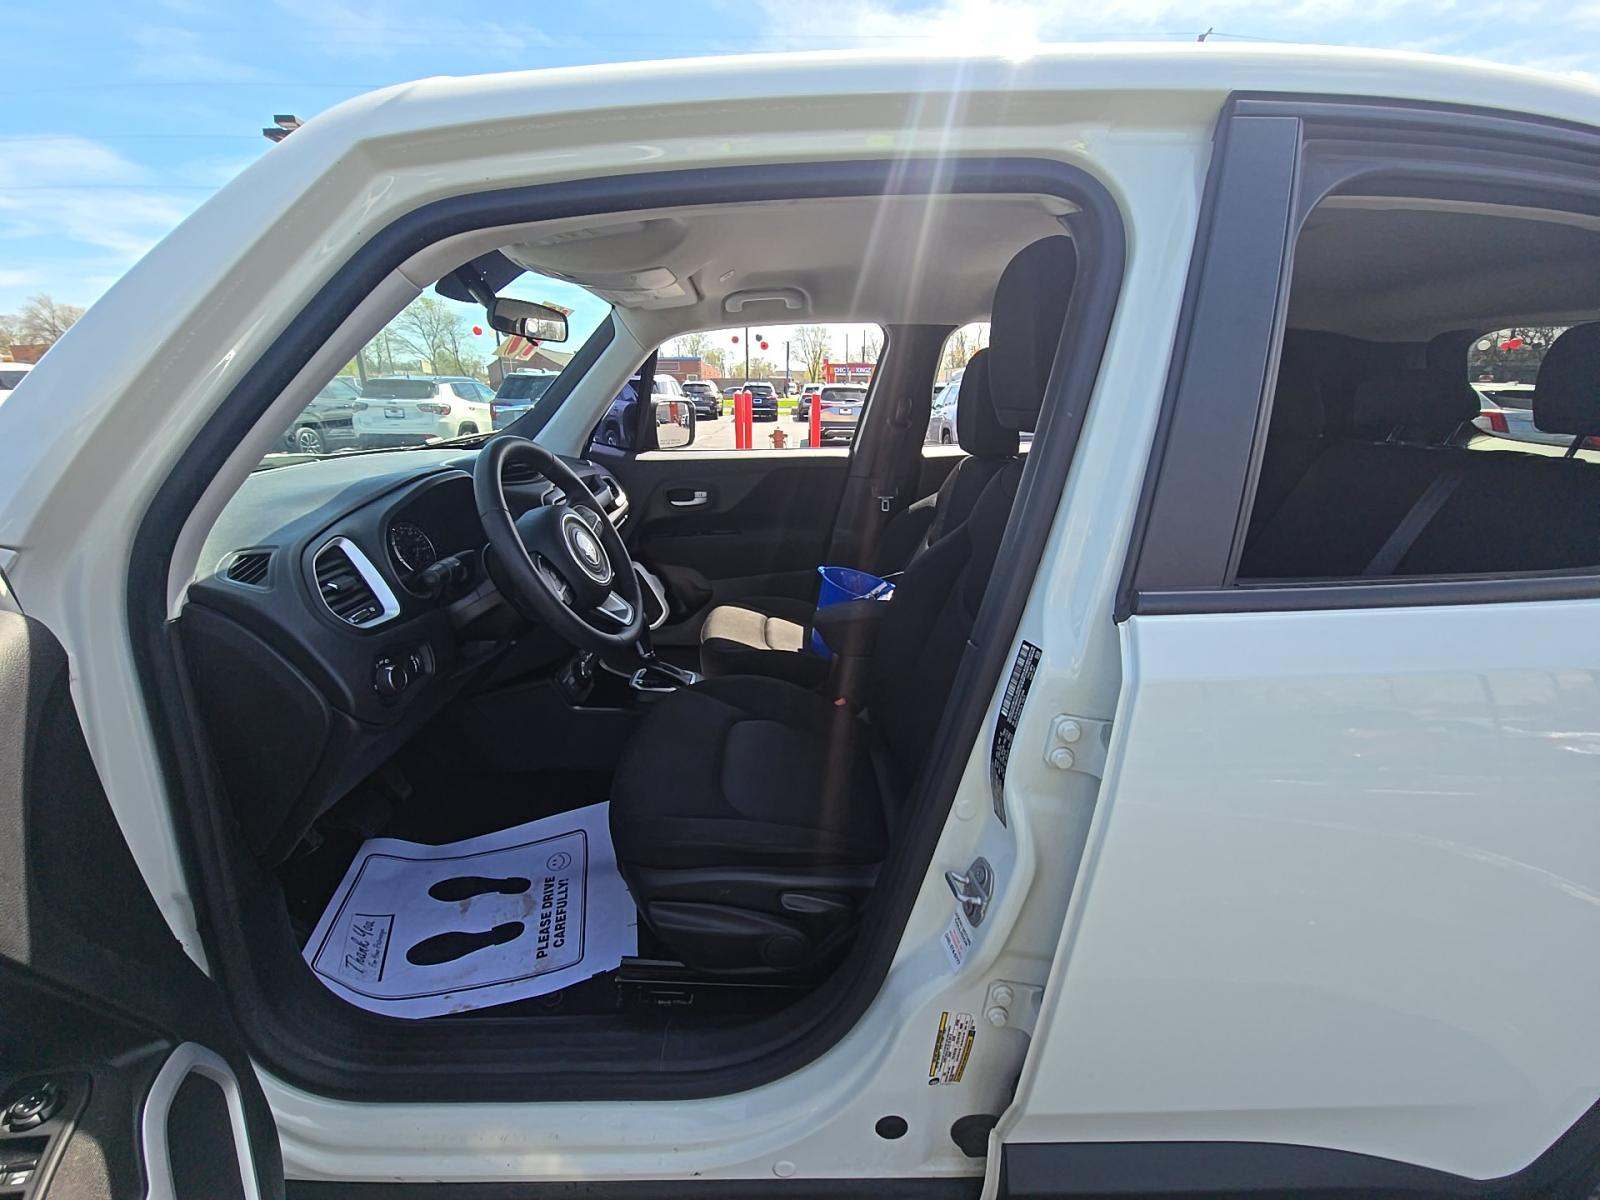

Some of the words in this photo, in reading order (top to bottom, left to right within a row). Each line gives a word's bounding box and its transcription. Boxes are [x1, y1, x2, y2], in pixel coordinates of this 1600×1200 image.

[542, 876, 556, 910] DRIVE
[352, 921, 375, 937] You
[553, 878, 569, 948] CAREFULLY!
[536, 911, 551, 960] PLEASE
[345, 936, 370, 973] Thank
